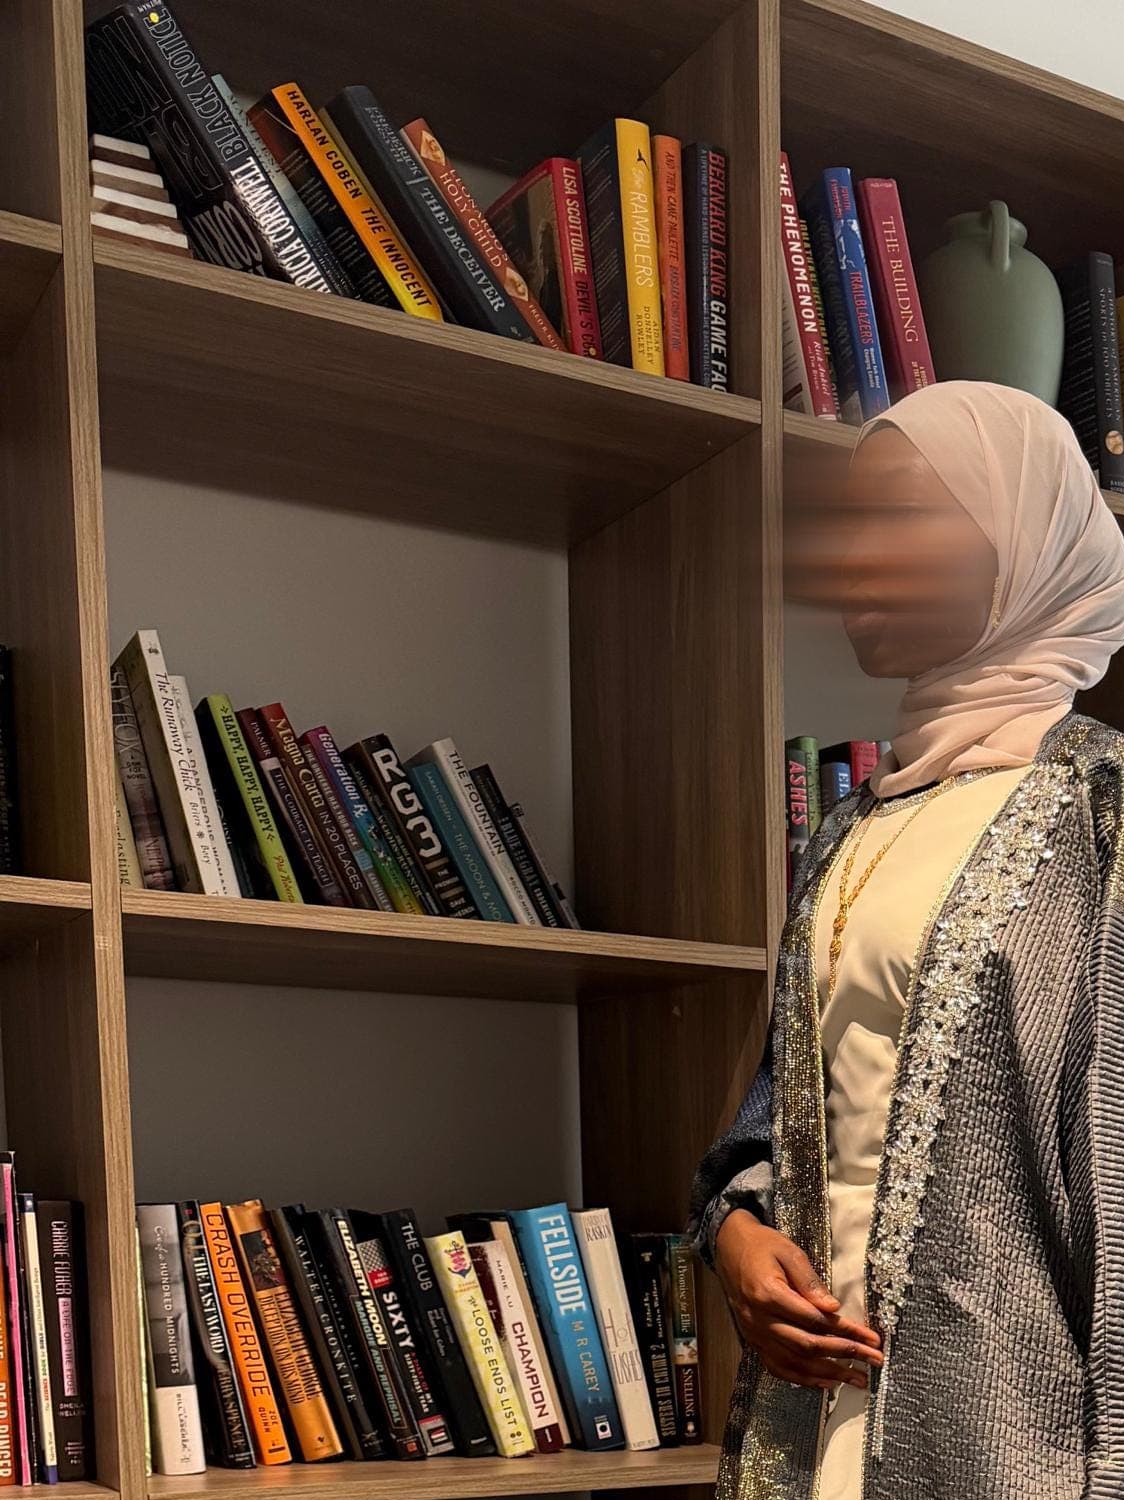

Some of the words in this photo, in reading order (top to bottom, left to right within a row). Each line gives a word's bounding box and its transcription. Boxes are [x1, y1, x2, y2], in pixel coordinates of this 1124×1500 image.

[143, 8, 205, 88] NOTICE
[188, 83, 248, 161] BLACK
[230, 156, 295, 243] CORNWELL
[286, 90, 329, 146] HARLAN
[326, 150, 363, 199] COBEN
[361, 207, 386, 235] THE
[379, 238, 432, 307] INNOCENT
[562, 166, 578, 195] LISA
[709, 150, 725, 245] BERNARD
[420, 187, 449, 225] THE
[443, 227, 506, 312] DECEIVER
[439, 172, 468, 219] HOLY
[468, 217, 502, 268] CHILD
[566, 198, 588, 276] SCOTTOLINE
[630, 191, 655, 288] RAMBLERS
[880, 214, 900, 254] THE
[710, 246, 726, 298] KING
[780, 201, 817, 334] PHENOMENON
[710, 300, 726, 357] GAME
[848, 270, 874, 345] TRAILBLAZERS
[889, 257, 918, 344] BUILDING
[151, 672, 167, 697] The
[158, 695, 184, 757] Runaway
[176, 756, 194, 793] Chick
[220, 712, 244, 754] HAPPY,
[235, 753, 259, 795] HAPPY,
[251, 793, 273, 834] HAPPY
[317, 730, 362, 802] Generation
[788, 760, 808, 826] ASHES
[269, 712, 305, 768] Magna
[296, 765, 326, 810] Carta
[318, 809, 332, 825] IN
[325, 824, 340, 843] 20
[333, 842, 363, 891] PLACES
[372, 748, 442, 858] RG3
[448, 749, 470, 780] THE
[463, 781, 505, 856] FOUNTAIN
[462, 851, 486, 889] MOON
[49, 1219, 69, 1258] CARRIE
[399, 1222, 420, 1251] THE
[535, 1212, 587, 1317] FELLSIDE
[158, 1261, 173, 1311] HUNDRED
[189, 1253, 210, 1282] THE
[196, 1281, 217, 1312] LAST
[337, 1220, 371, 1298] ELIZABETH
[363, 1298, 388, 1347] MOON
[409, 1251, 433, 1292] CLUB
[677, 1265, 690, 1299] Promise
[203, 1313, 226, 1354] WORD
[204, 1210, 240, 1287] CRASH
[225, 1289, 270, 1398] OVERRIDE
[257, 1293, 287, 1347] DECEPTION
[292, 1235, 324, 1305] WALTER
[317, 1312, 357, 1404] CRONKITE
[380, 1289, 415, 1351] SIXTY
[570, 1319, 585, 1332] M
[679, 1312, 691, 1333] Ellie
[164, 1315, 180, 1374] MIDNIGHTS
[273, 1345, 292, 1363] ON
[274, 1289, 306, 1353] ELIZABETH
[294, 1352, 321, 1401] GEORGE
[354, 1300, 376, 1350] MARQUE
[371, 1350, 384, 1375] AND
[378, 1374, 401, 1424] REPRISAL
[470, 1308, 494, 1355] LOOSE
[487, 1357, 507, 1395] ENDS
[500, 1397, 518, 1427] LIST
[494, 1258, 509, 1291] MARIE
[504, 1294, 514, 1309] LU
[509, 1320, 549, 1418] CHAMPION
[575, 1336, 589, 1348] R
[278, 1360, 297, 1380] HIS
[283, 1377, 305, 1406] MIND
[577, 1350, 600, 1394] CAREY
[681, 1367, 697, 1417] SNELLING
[223, 1400, 247, 1449] SPENCE
[256, 1406, 270, 1434] QUINN
[267, 1409, 278, 1426] ZOE
